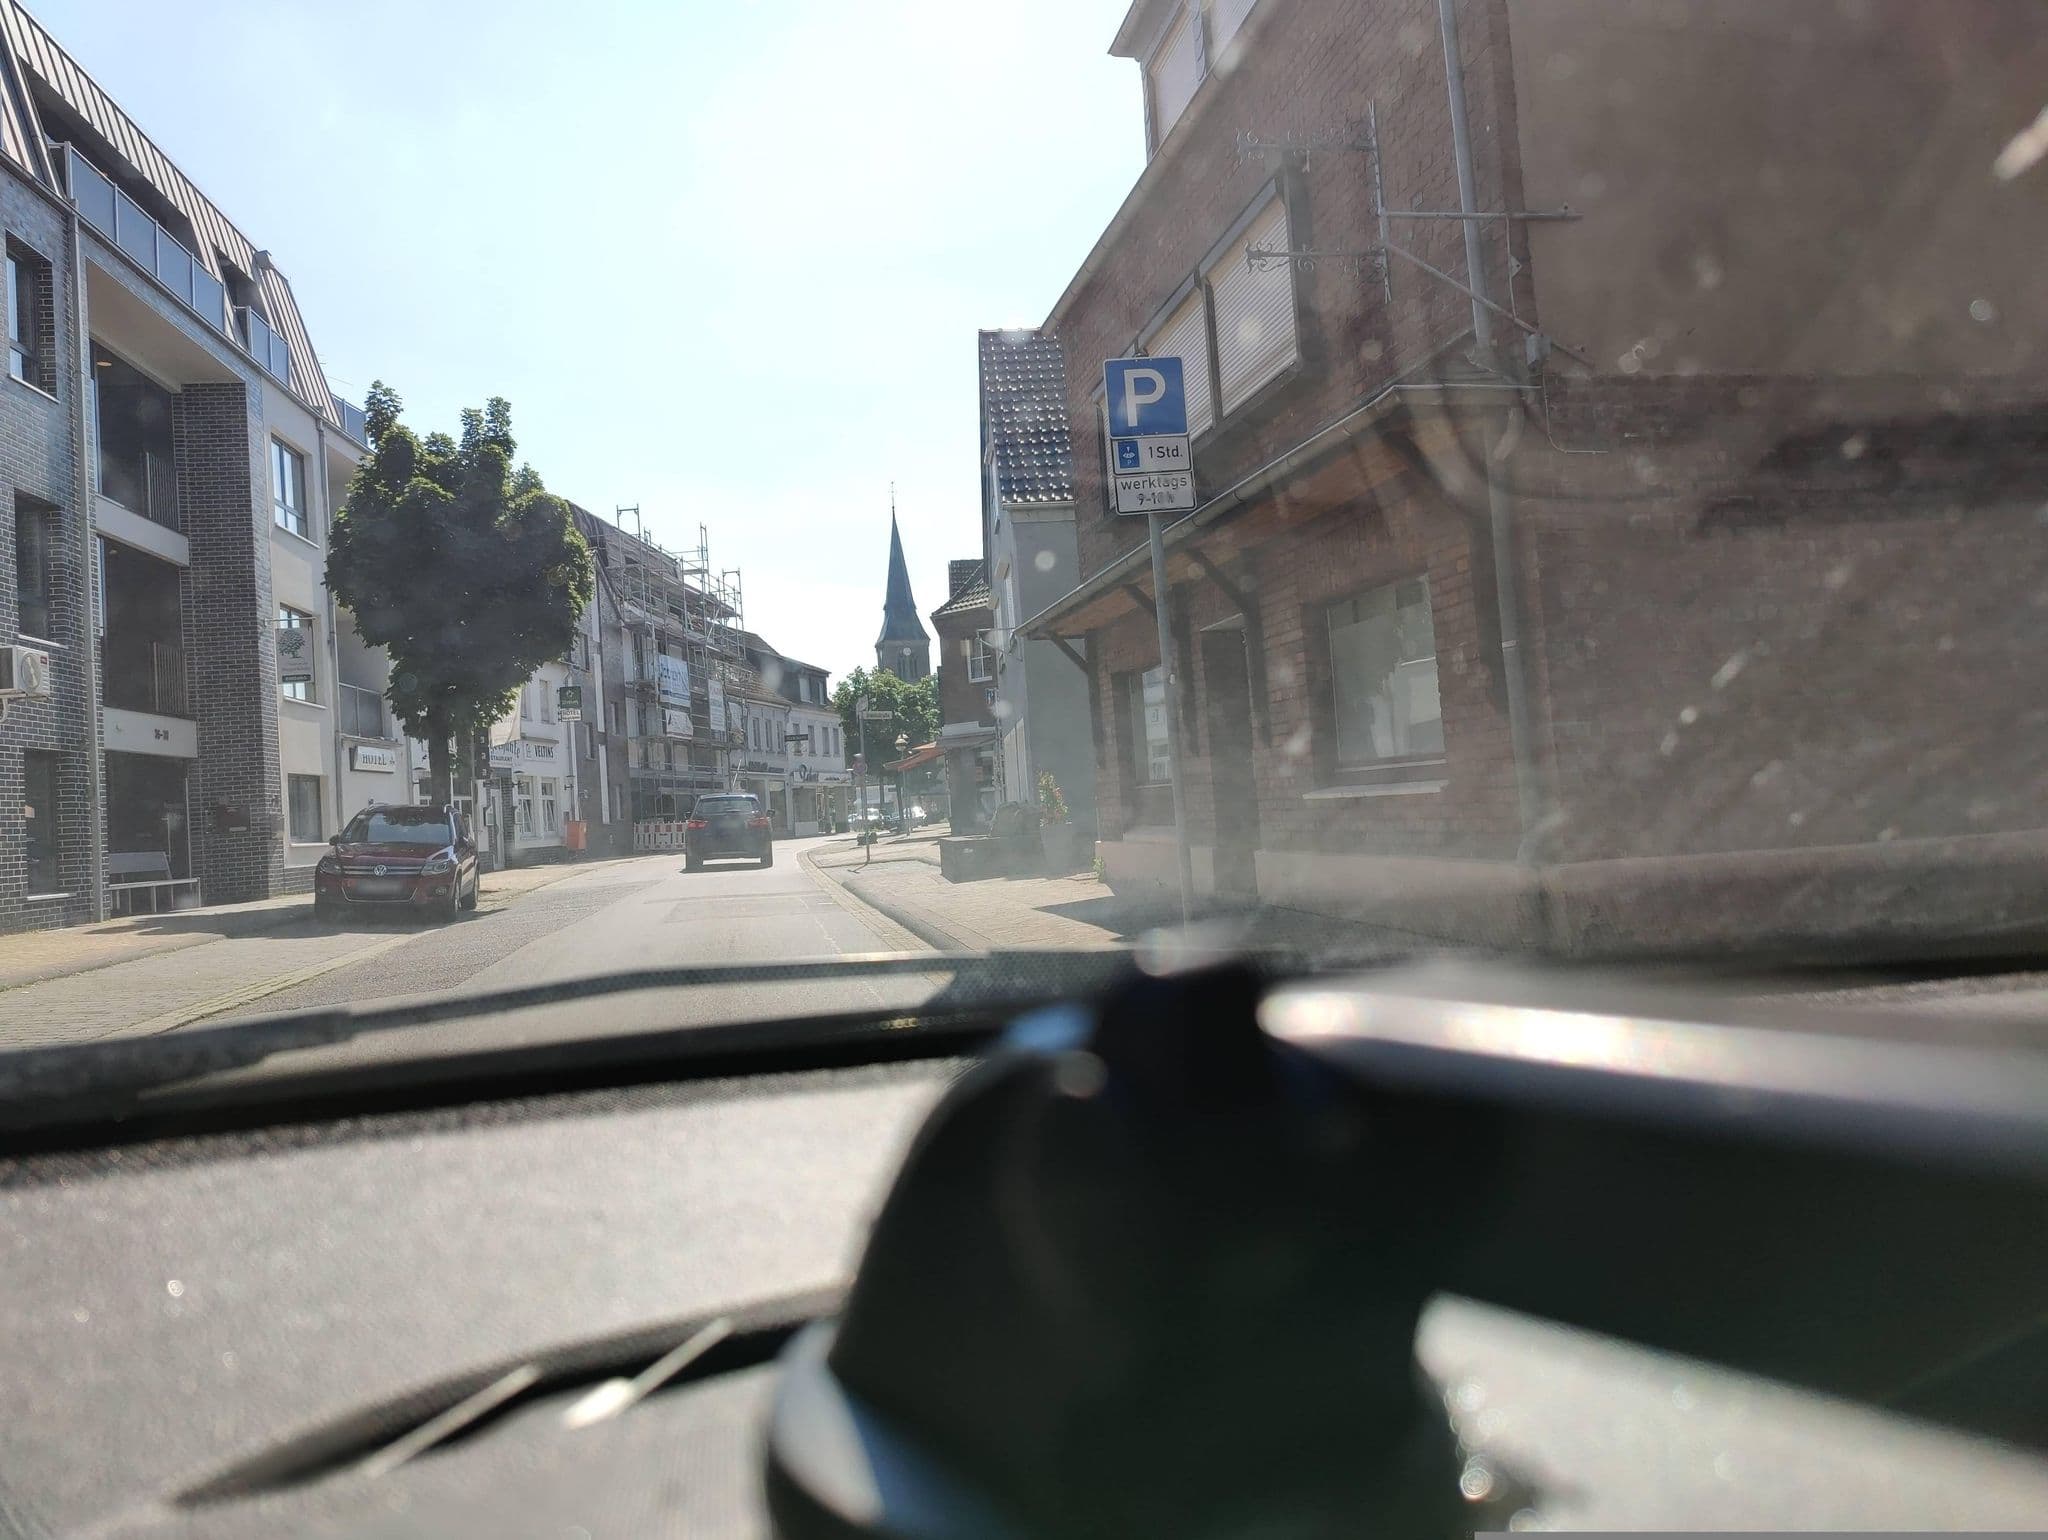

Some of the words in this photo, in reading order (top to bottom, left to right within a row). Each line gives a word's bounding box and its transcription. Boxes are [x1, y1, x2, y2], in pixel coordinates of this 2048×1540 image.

[1123, 368, 1166, 427] P
[1120, 476, 1187, 490] werktags
[534, 744, 554, 758] VELTINS
[362, 754, 387, 766] HOTEL
